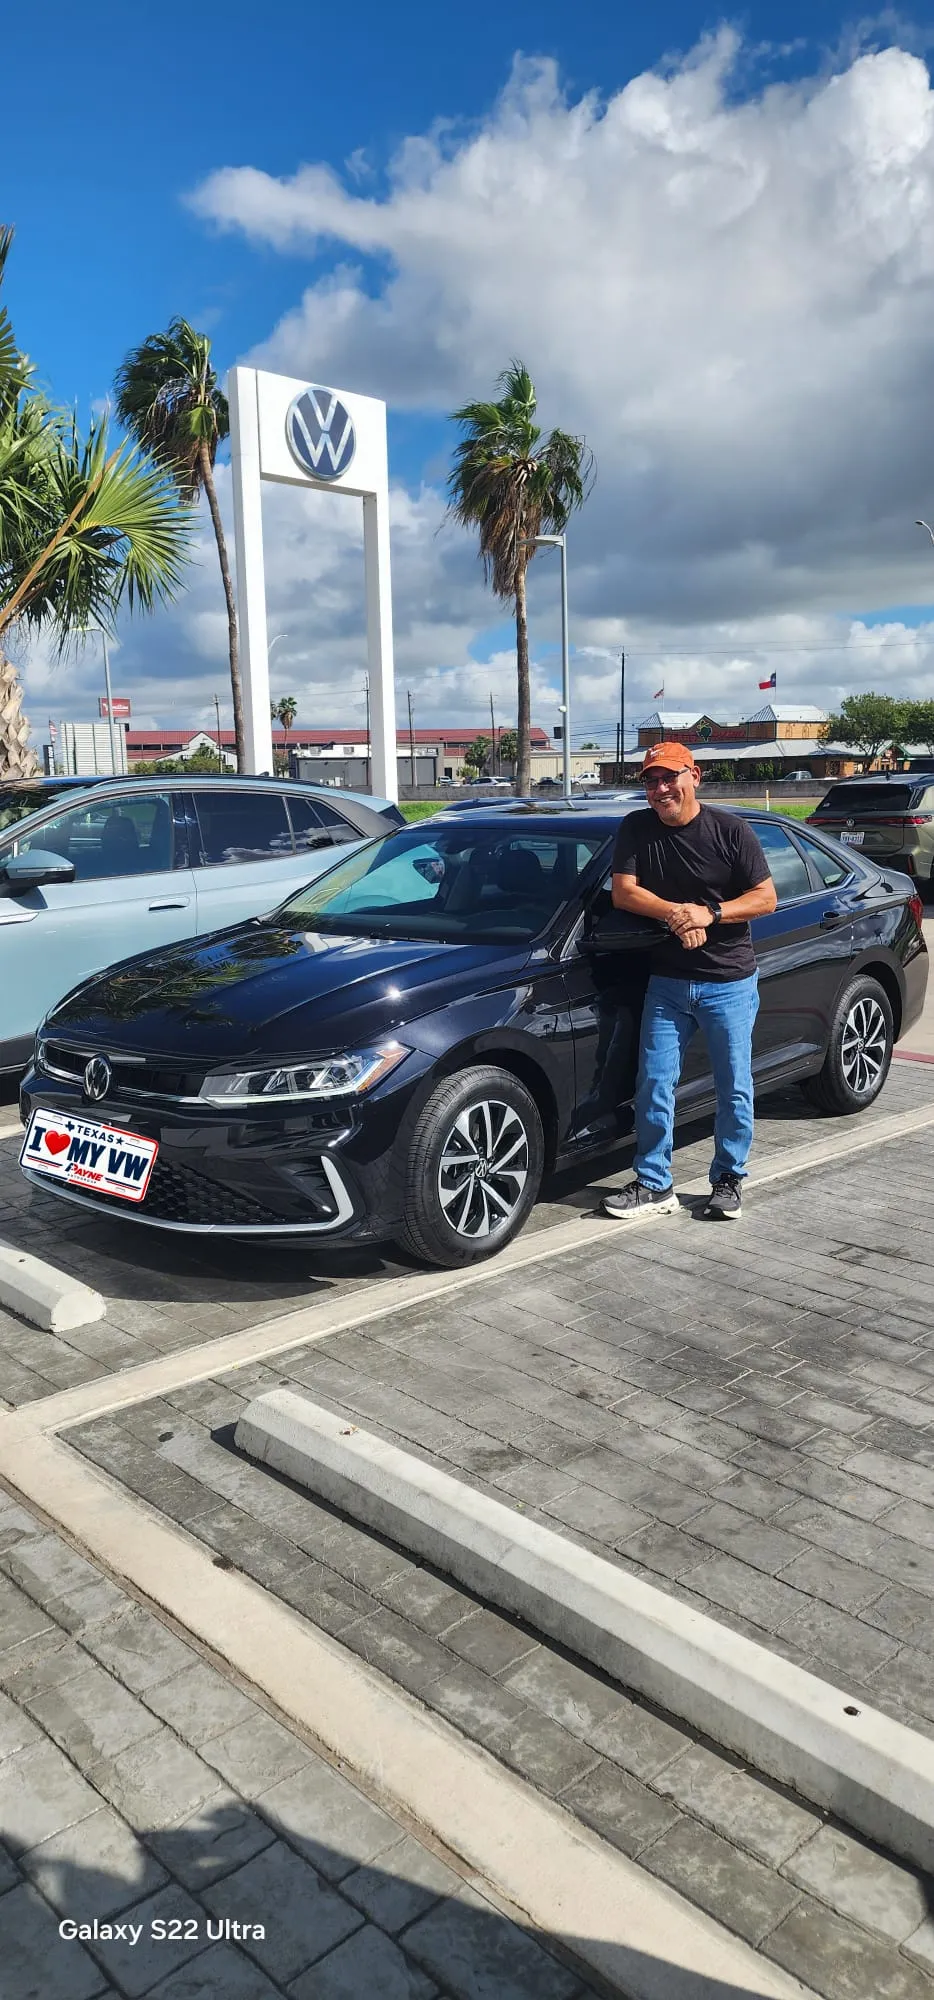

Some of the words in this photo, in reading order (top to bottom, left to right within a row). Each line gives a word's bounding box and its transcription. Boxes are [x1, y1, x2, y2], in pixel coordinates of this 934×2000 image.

[77, 1125, 114, 1143] TEXAS
[29, 1125, 46, 1151] I
[67, 1138, 106, 1168] MY
[108, 1148, 149, 1181] VW
[65, 1163, 103, 1181] PAYNE
